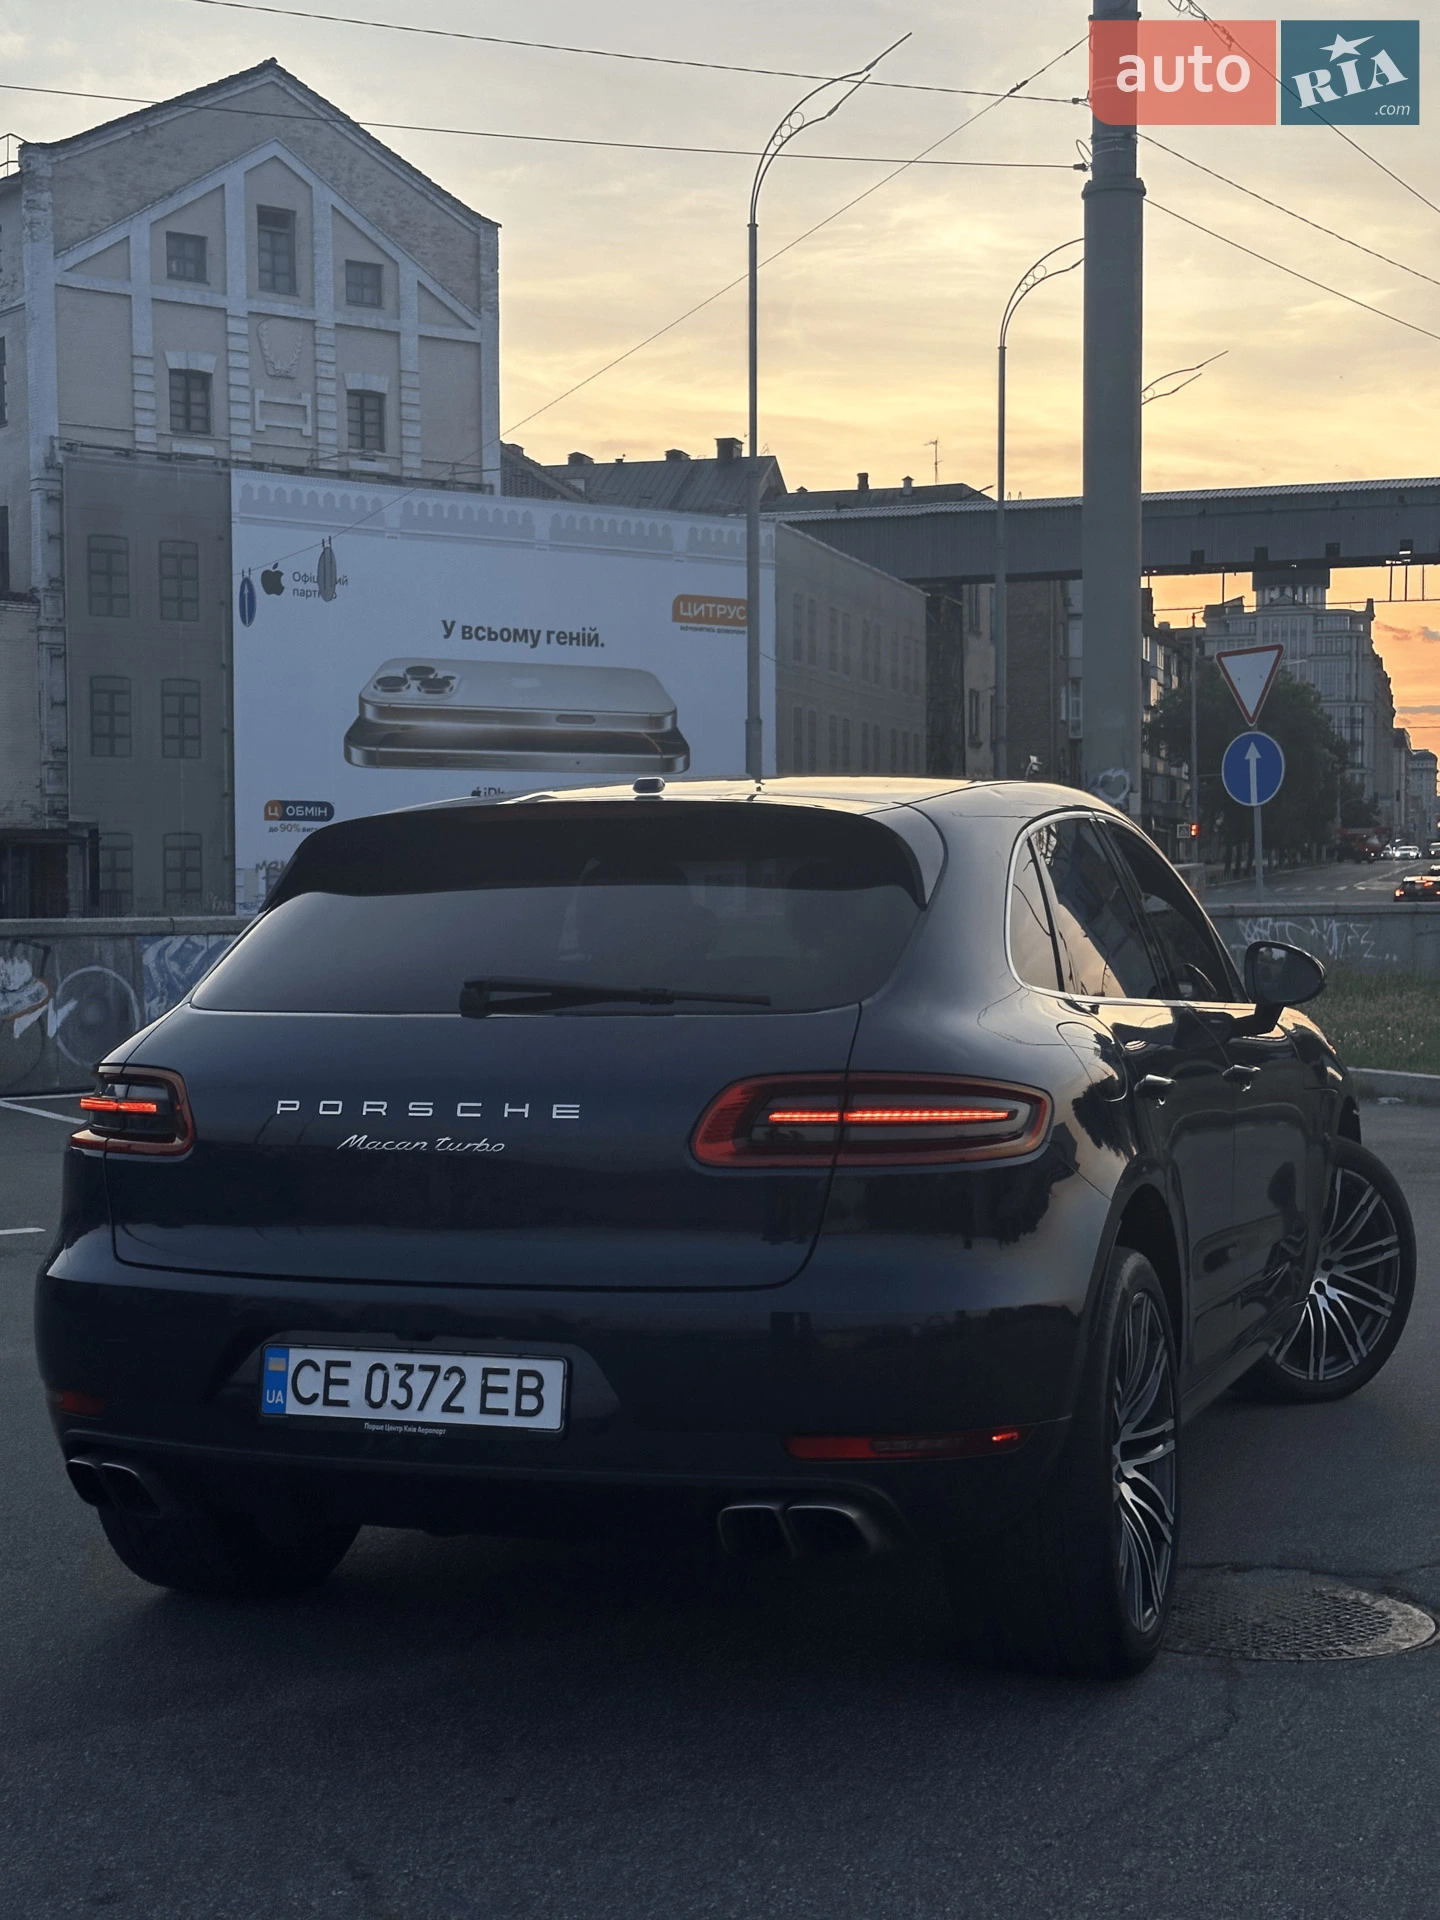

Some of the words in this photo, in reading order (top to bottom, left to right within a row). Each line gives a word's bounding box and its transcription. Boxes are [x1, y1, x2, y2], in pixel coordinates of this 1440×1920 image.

[680, 601, 746, 620] ЦИТРУС
[441, 620, 456, 639] У
[461, 625, 542, 649] всьому
[546, 627, 605, 648] геній.
[286, 805, 328, 817] ОБМІН
[268, 825, 278, 833] до
[279, 823, 300, 833] 90%
[276, 1100, 580, 1119] PORSCHE
[336, 1134, 428, 1150] Macan
[435, 1136, 505, 1152] turbo
[266, 1389, 284, 1404] UA
[291, 1359, 351, 1407] CE
[364, 1362, 466, 1414] 0372
[480, 1367, 544, 1417] EB
[364, 1422, 384, 1431] Порше
[385, 1424, 403, 1433] Центр
